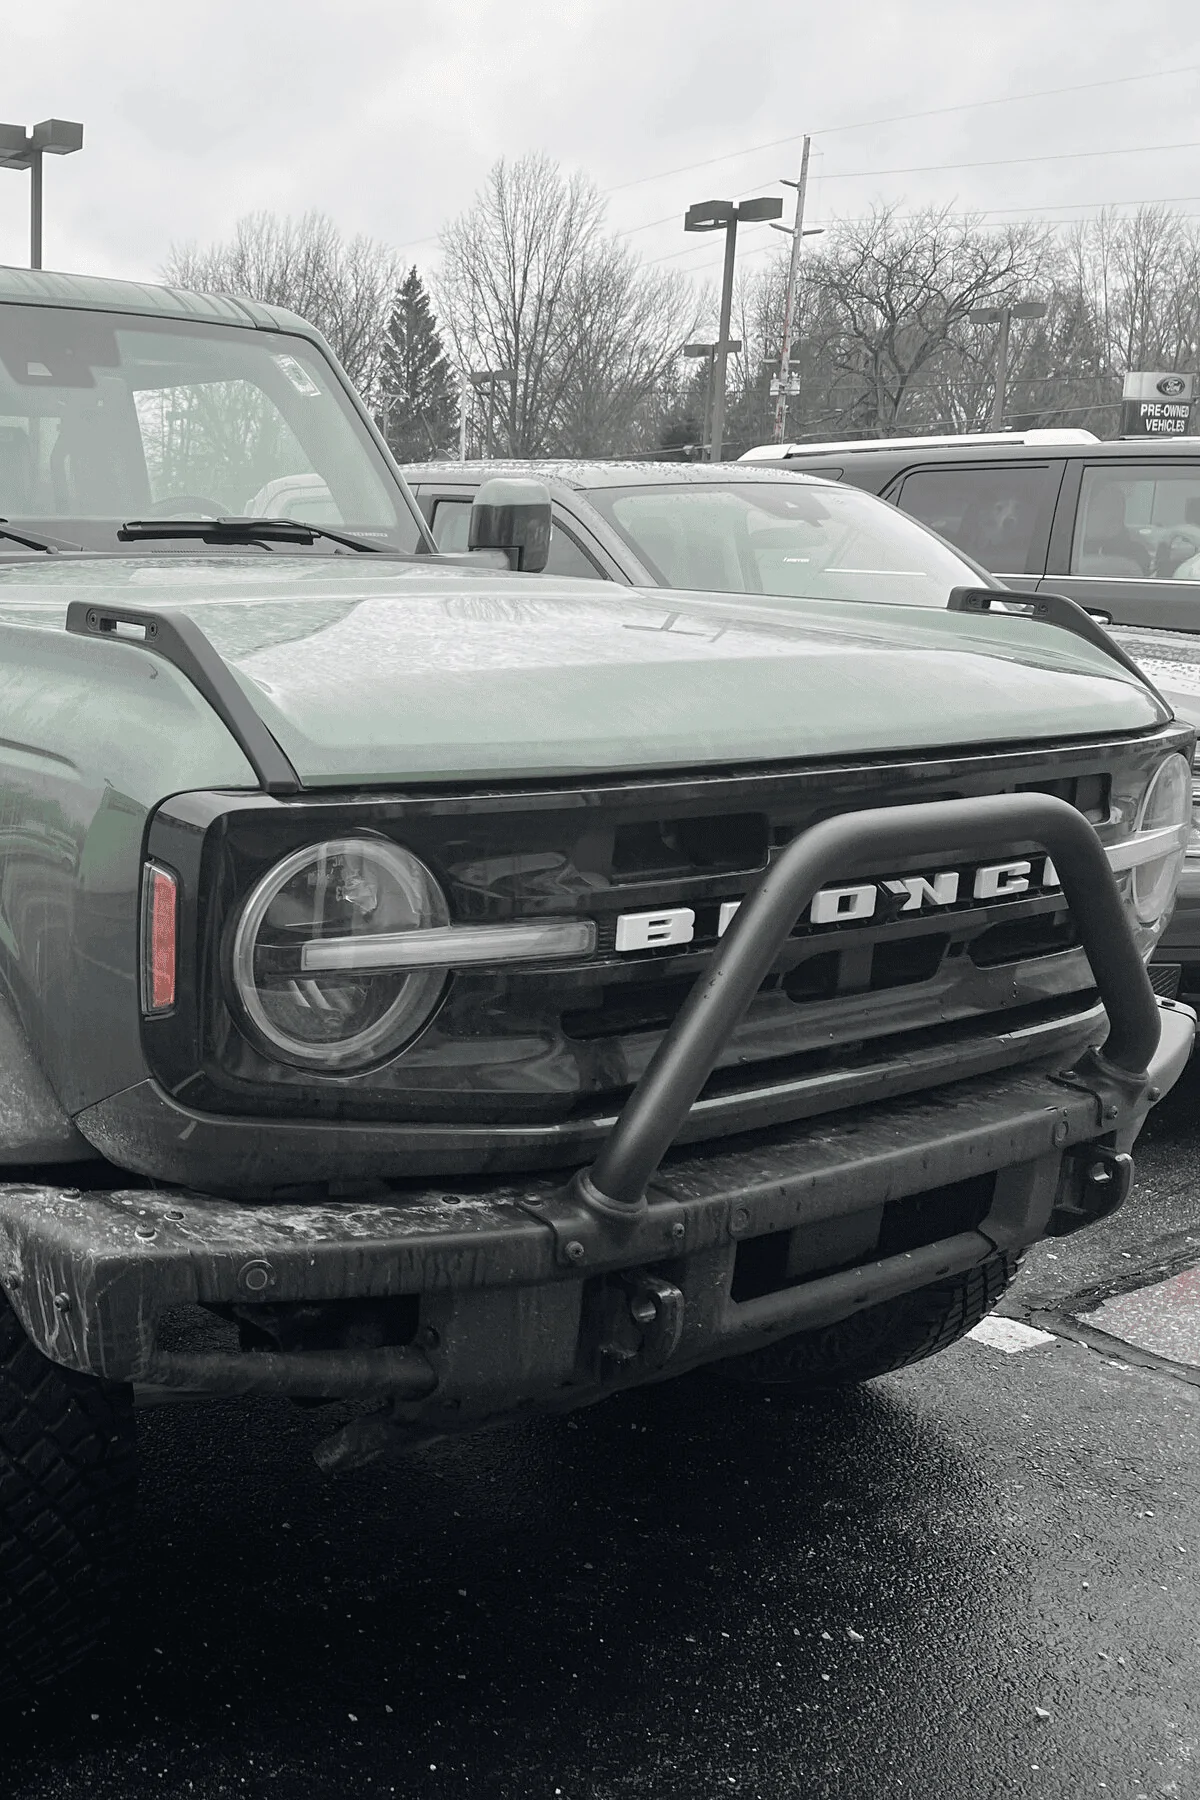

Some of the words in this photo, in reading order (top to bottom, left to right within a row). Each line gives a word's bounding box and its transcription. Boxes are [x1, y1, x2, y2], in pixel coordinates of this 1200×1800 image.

[1140, 403, 1190, 418] PRE-OWNED
[1145, 418, 1185, 432] VEHICLES
[615, 855, 1061, 953] BONC
